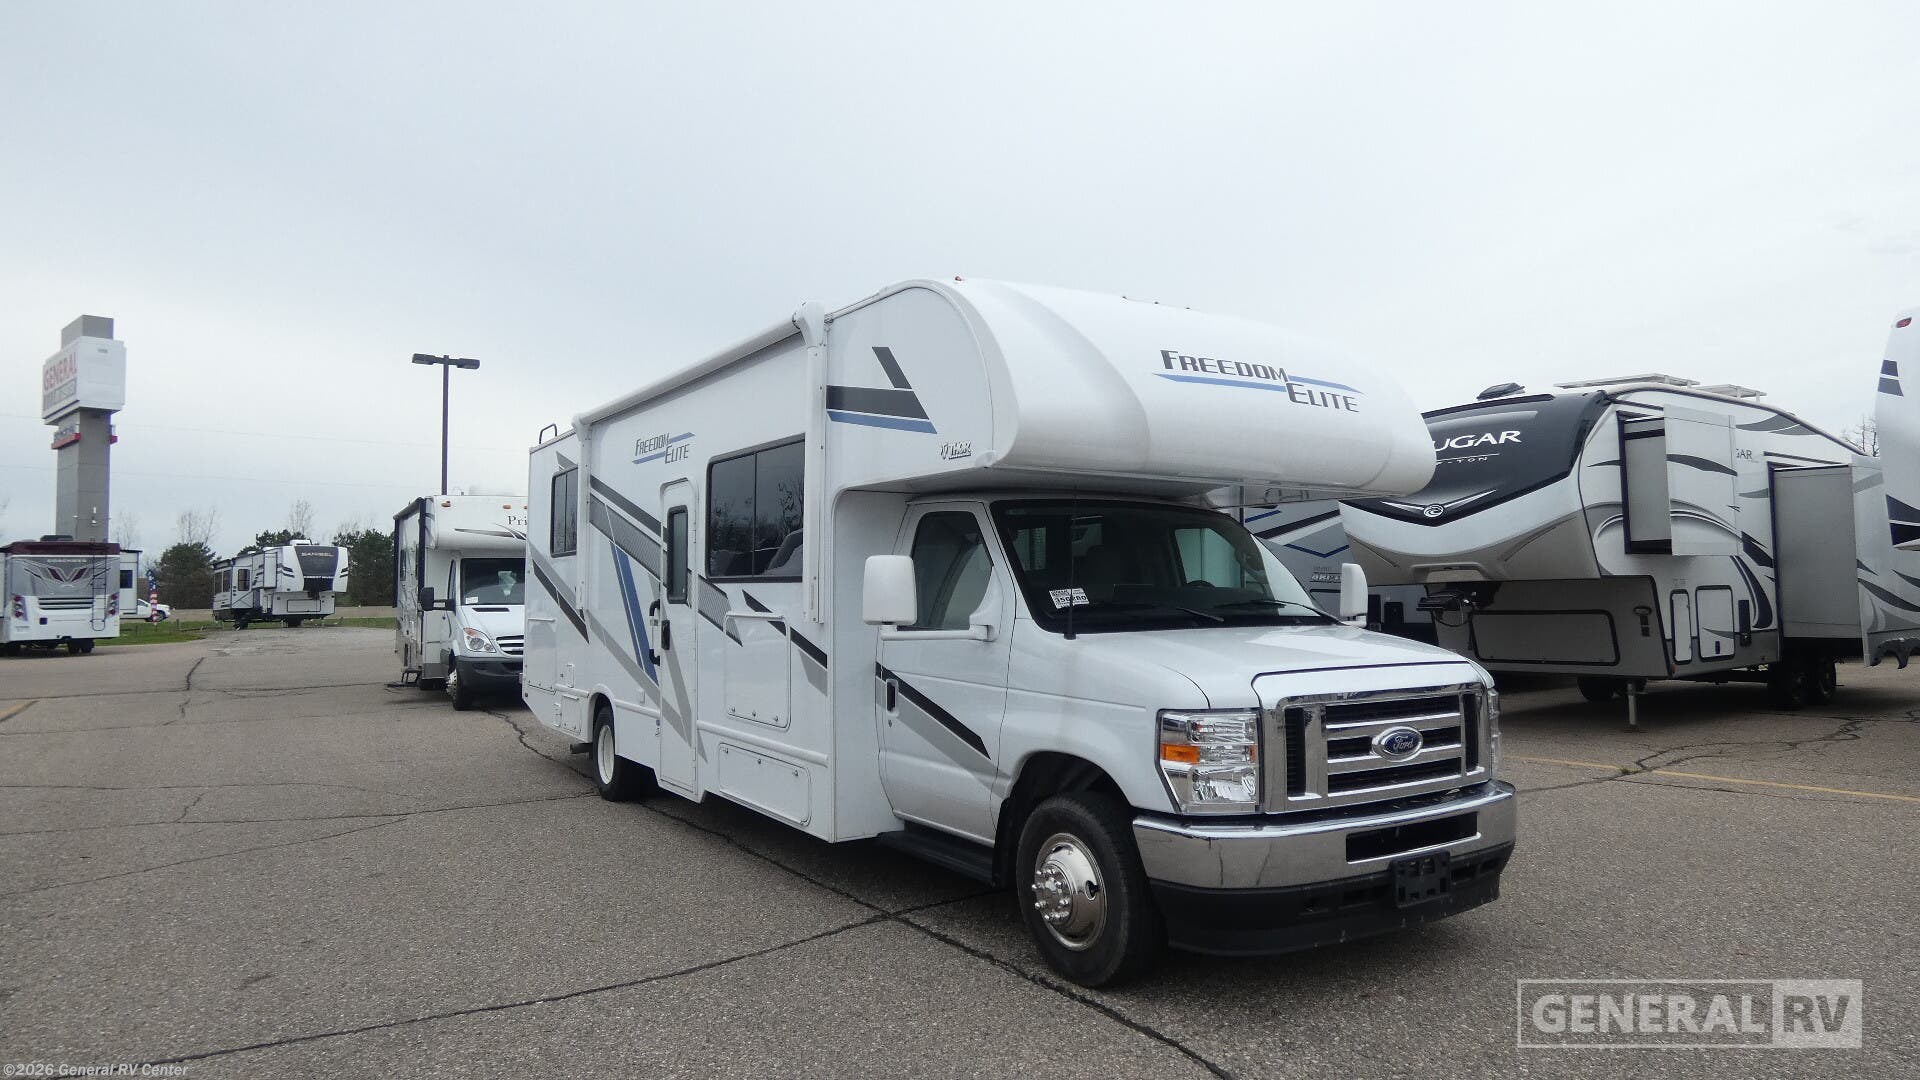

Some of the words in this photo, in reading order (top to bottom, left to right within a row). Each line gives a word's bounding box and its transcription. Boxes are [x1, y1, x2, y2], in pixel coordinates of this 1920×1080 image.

[1160, 349, 1289, 383] FREEDOM
[1286, 382, 1360, 413] ELITE
[634, 432, 672, 457] FREEDOM
[1433, 430, 1522, 452] UGAR
[664, 443, 691, 465] ELITE
[508, 515, 528, 526] Pri
[1392, 735, 1414, 753] Ford
